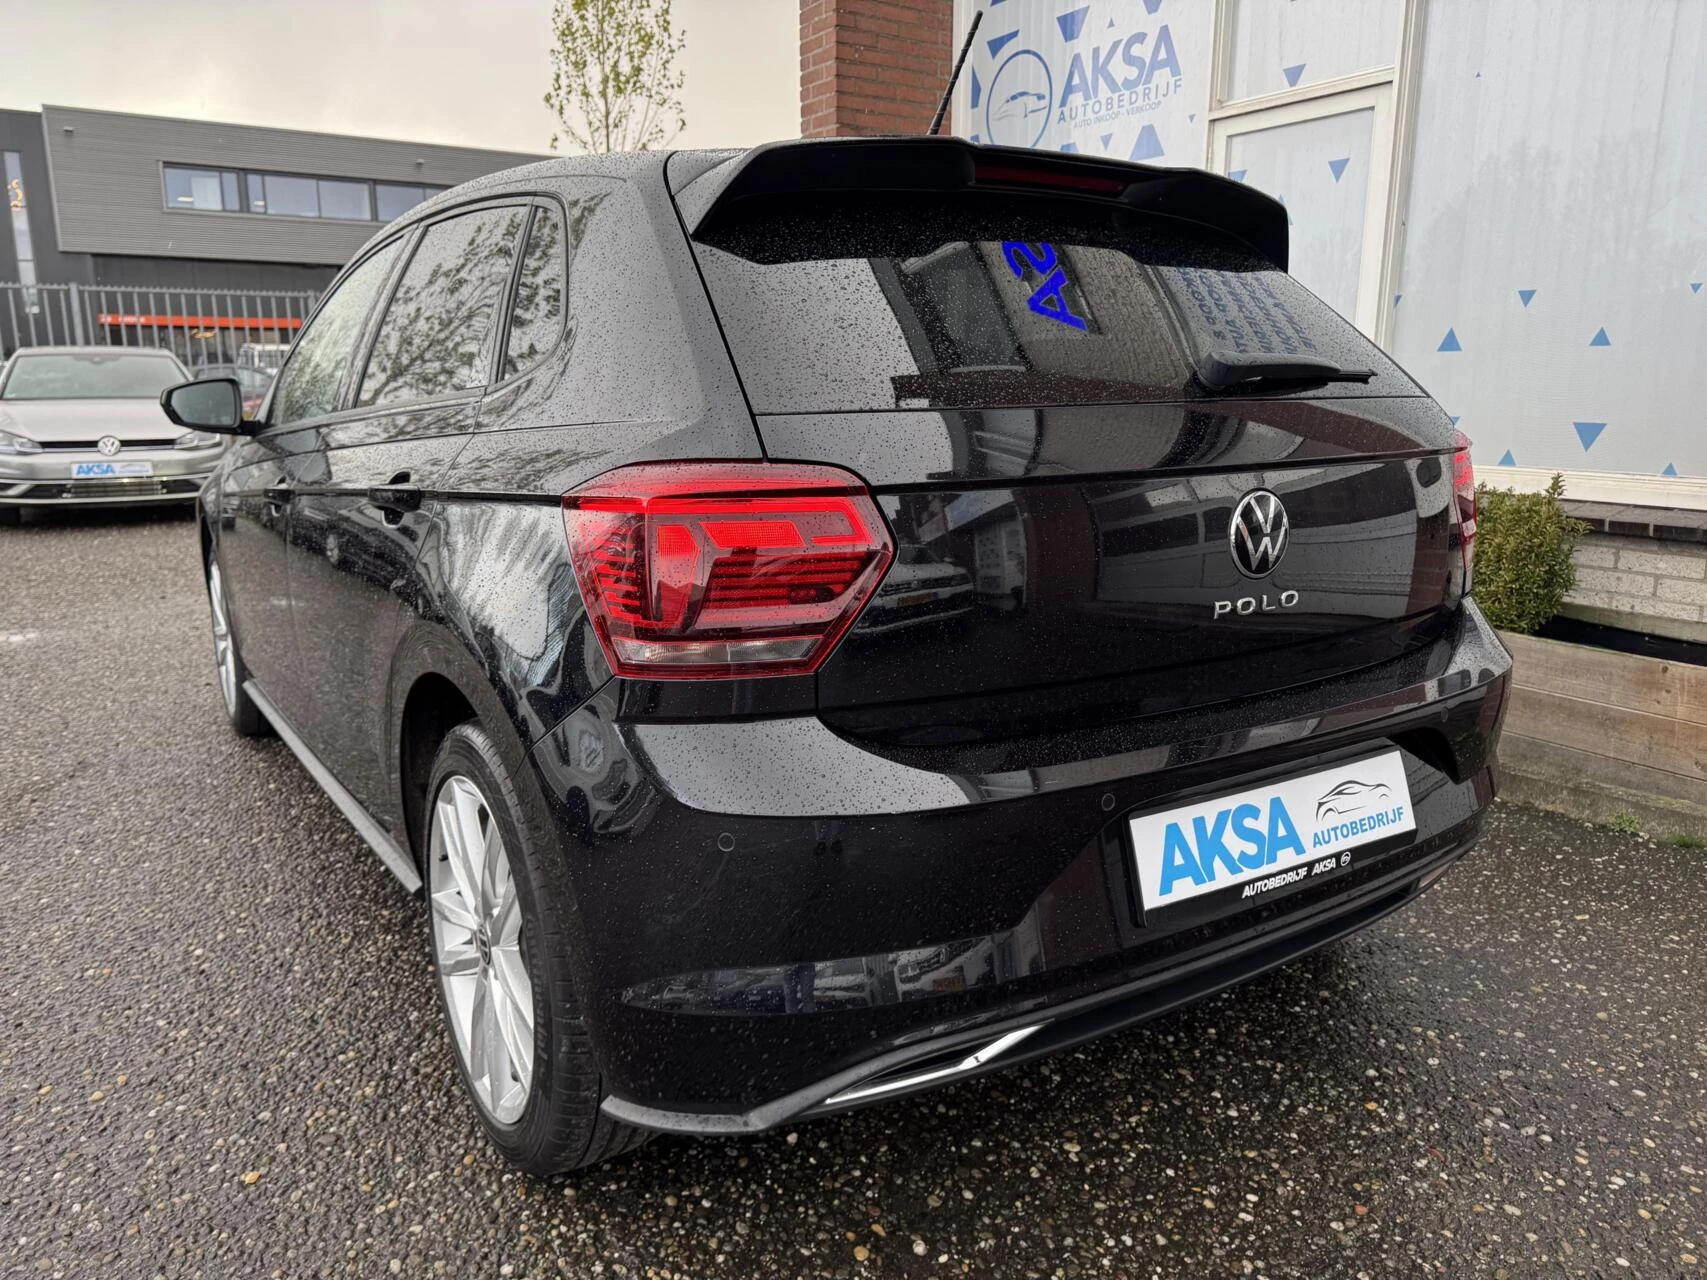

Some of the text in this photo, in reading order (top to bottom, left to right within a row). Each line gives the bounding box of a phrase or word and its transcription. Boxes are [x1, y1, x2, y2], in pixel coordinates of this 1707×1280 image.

[1059, 24, 1182, 108] AKSA
[1057, 78, 1182, 124] AUTOBEDRIJF
[1073, 117, 1094, 129] AUTO
[1125, 100, 1162, 117] VERKOOP
[76, 463, 115, 475] AKSA
[1213, 590, 1299, 619] POLO
[1158, 796, 1305, 896] AKSA
[1312, 806, 1404, 849] AUTOBEDRIJF
[1241, 857, 1336, 898] AUTOBEDRIJF AKSA
